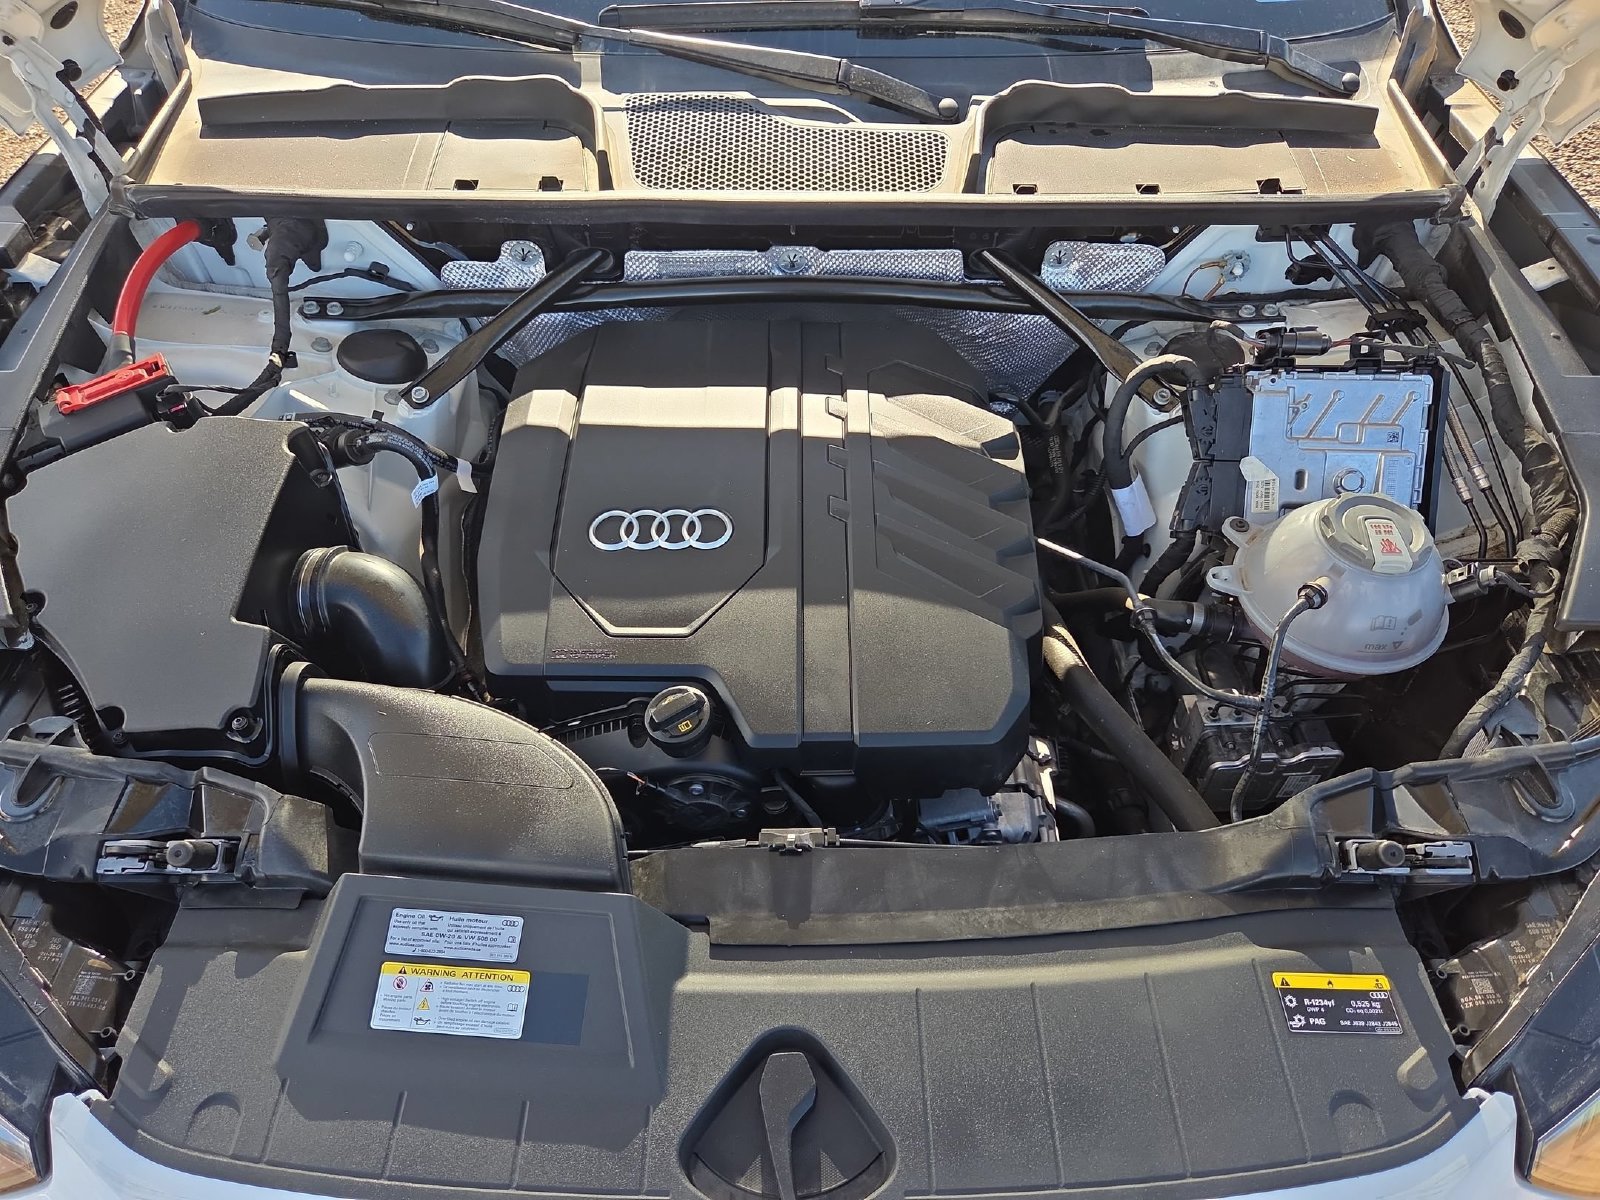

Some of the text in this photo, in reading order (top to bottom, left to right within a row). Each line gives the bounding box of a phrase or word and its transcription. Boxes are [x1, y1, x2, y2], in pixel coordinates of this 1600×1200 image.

[410, 968, 514, 981] WARNING ATTENTION
[1304, 998, 1335, 1007] R-1234yf
